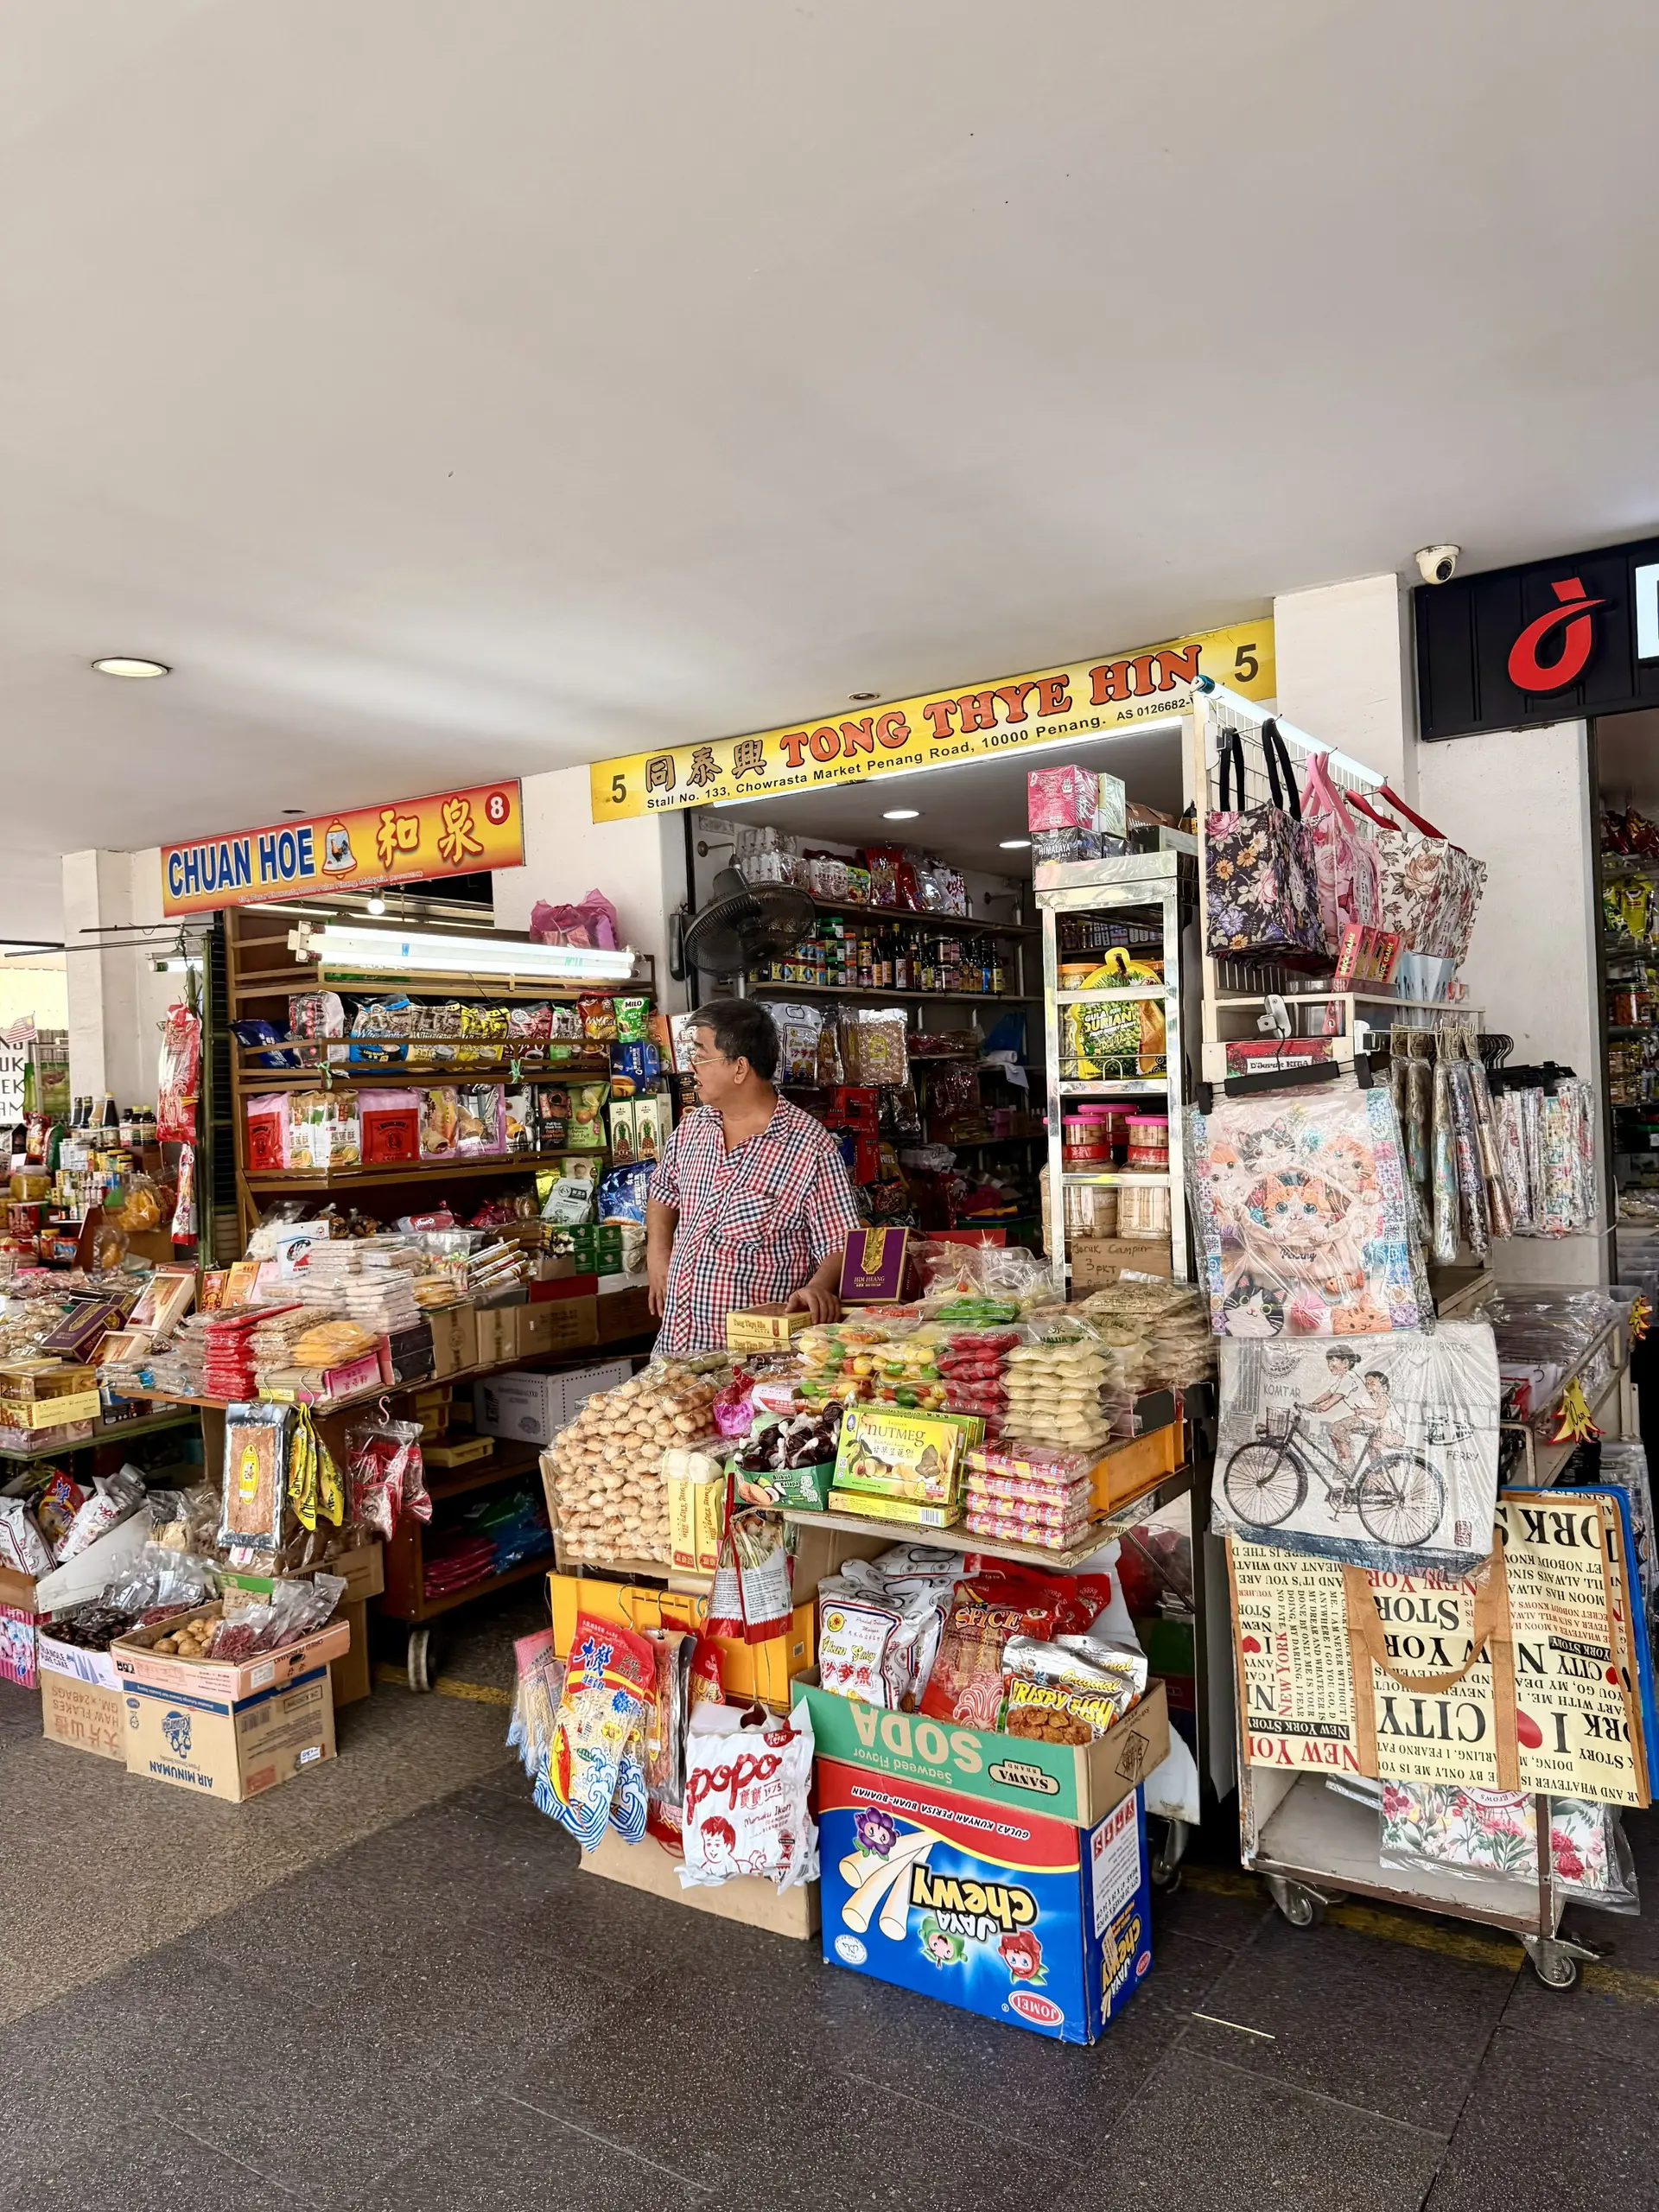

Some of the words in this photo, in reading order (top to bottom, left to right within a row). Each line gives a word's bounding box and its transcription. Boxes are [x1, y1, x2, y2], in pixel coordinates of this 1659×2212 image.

[1234, 644, 1259, 683] 5
[779, 711, 911, 767] TONG
[924, 673, 1072, 739] THYE
[1089, 645, 1202, 705] HIN
[647, 796, 674, 809] Stall
[679, 793, 699, 804] No.
[705, 786, 730, 798] 133,
[736, 772, 807, 793] Chowrasta
[813, 763, 861, 780] Market
[868, 753, 923, 771] Penang
[930, 741, 975, 759] Road,
[982, 730, 1028, 748] 10000
[1036, 715, 1106, 737] Penang.
[1116, 709, 1133, 721] AS
[612, 774, 626, 803] 5
[490, 796, 504, 819] 8
[376, 797, 485, 870] 和泉
[1039, 842, 1071, 855] HIMALAYA
[168, 836, 252, 899] CHUAN
[257, 825, 316, 884] HOE
[1345, 931, 1356, 955] GAME
[1384, 942, 1394, 963] GAME
[1084, 1010, 1106, 1022] GULA
[1085, 1258, 1095, 1270] 3
[1280, 1248, 1317, 1263] Penang
[1263, 1383, 1301, 1398] KOMTAR
[1446, 1450, 1479, 1462] FERRY
[1243, 1546, 1267, 1557] THE
[1274, 1561, 1297, 1572] AND
[1300, 1561, 1343, 1573] MEANT
[1238, 1574, 1262, 1585] ARE
[1265, 1575, 1287, 1586] YOU
[1292, 1576, 1314, 1587] IT'S
[1319, 1576, 1344, 1588] AND
[1545, 1586, 1565, 1601] HAS
[1568, 1592, 1605, 1605] MOON
[1298, 1590, 1306, 1617] DONE
[955, 1606, 1023, 1632] SPICE
[1242, 1620, 1272, 1631] NEW
[1524, 1622, 1552, 1631] MOON
[1275, 1632, 1291, 1675] YORK
[1557, 1654, 1602, 1681] CITY
[1059, 1669, 1120, 1693] Original
[1548, 1680, 1568, 1691] MY
[1573, 1681, 1594, 1695] GO,
[1279, 1679, 1293, 1718] NEW
[1527, 1693, 1553, 1704] ME.
[1599, 1689, 1624, 1701] YOU
[53, 1700, 91, 1719] FLAKES
[1558, 1695, 1592, 1713] WITH
[96, 1712, 118, 1727] HAW
[1284, 1719, 1317, 1736] YORK
[1376, 1695, 1485, 1743] CITY
[849, 1702, 983, 1773] SODA
[1319, 1724, 1347, 1738] NEW
[853, 1748, 890, 1768] Flavor
[1398, 1745, 1442, 1758] FEARNO
[1579, 1747, 1624, 1770] STORY
[149, 1760, 196, 1784] MINUMAN
[892, 1758, 953, 1784] Seaweed
[1400, 1764, 1410, 1773] IS
[1414, 1764, 1431, 1775] ME
[1531, 1756, 1573, 1771] DOING,
[198, 1770, 213, 1789] AIR
[1000, 1770, 1049, 1790] SANWA
[1435, 1767, 1465, 1779] ONLY
[1469, 1770, 1483, 1780] BY
[1521, 1776, 1531, 1786] IS
[685, 1752, 782, 1826] popo
[765, 1783, 782, 1797] 1975
[1535, 1777, 1597, 1795] WHATEVER
[1600, 1787, 1624, 1799] AND
[851, 1786, 918, 1810] BUAH-BUAHAN
[1480, 1792, 1510, 1802] grows
[920, 1803, 953, 1820] PERISA
[956, 1812, 995, 1831] KUNYAH
[997, 1823, 1029, 1840] GULA2
[911, 1865, 1036, 1929] chewy
[936, 1909, 997, 1942] JAYA
[1015, 1995, 1058, 2020] JOMEI
